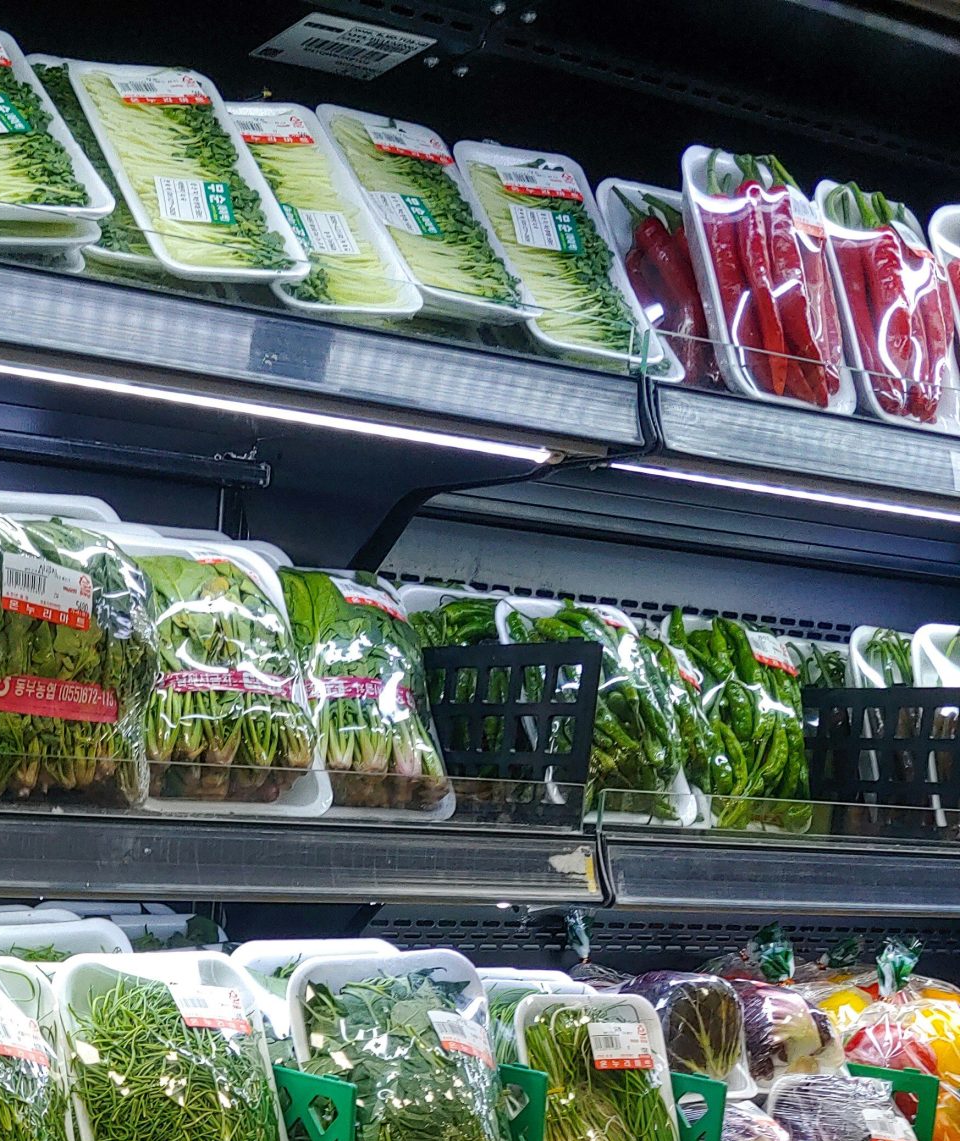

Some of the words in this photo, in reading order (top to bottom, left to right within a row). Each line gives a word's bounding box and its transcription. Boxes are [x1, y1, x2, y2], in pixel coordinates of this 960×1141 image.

[208, 183, 226, 205] 무순
[405, 197, 426, 217] 무순
[555, 213, 573, 234] 무순
[9, 600, 85, 628] 온누리마트
[14, 678, 57, 700] 동부농협
